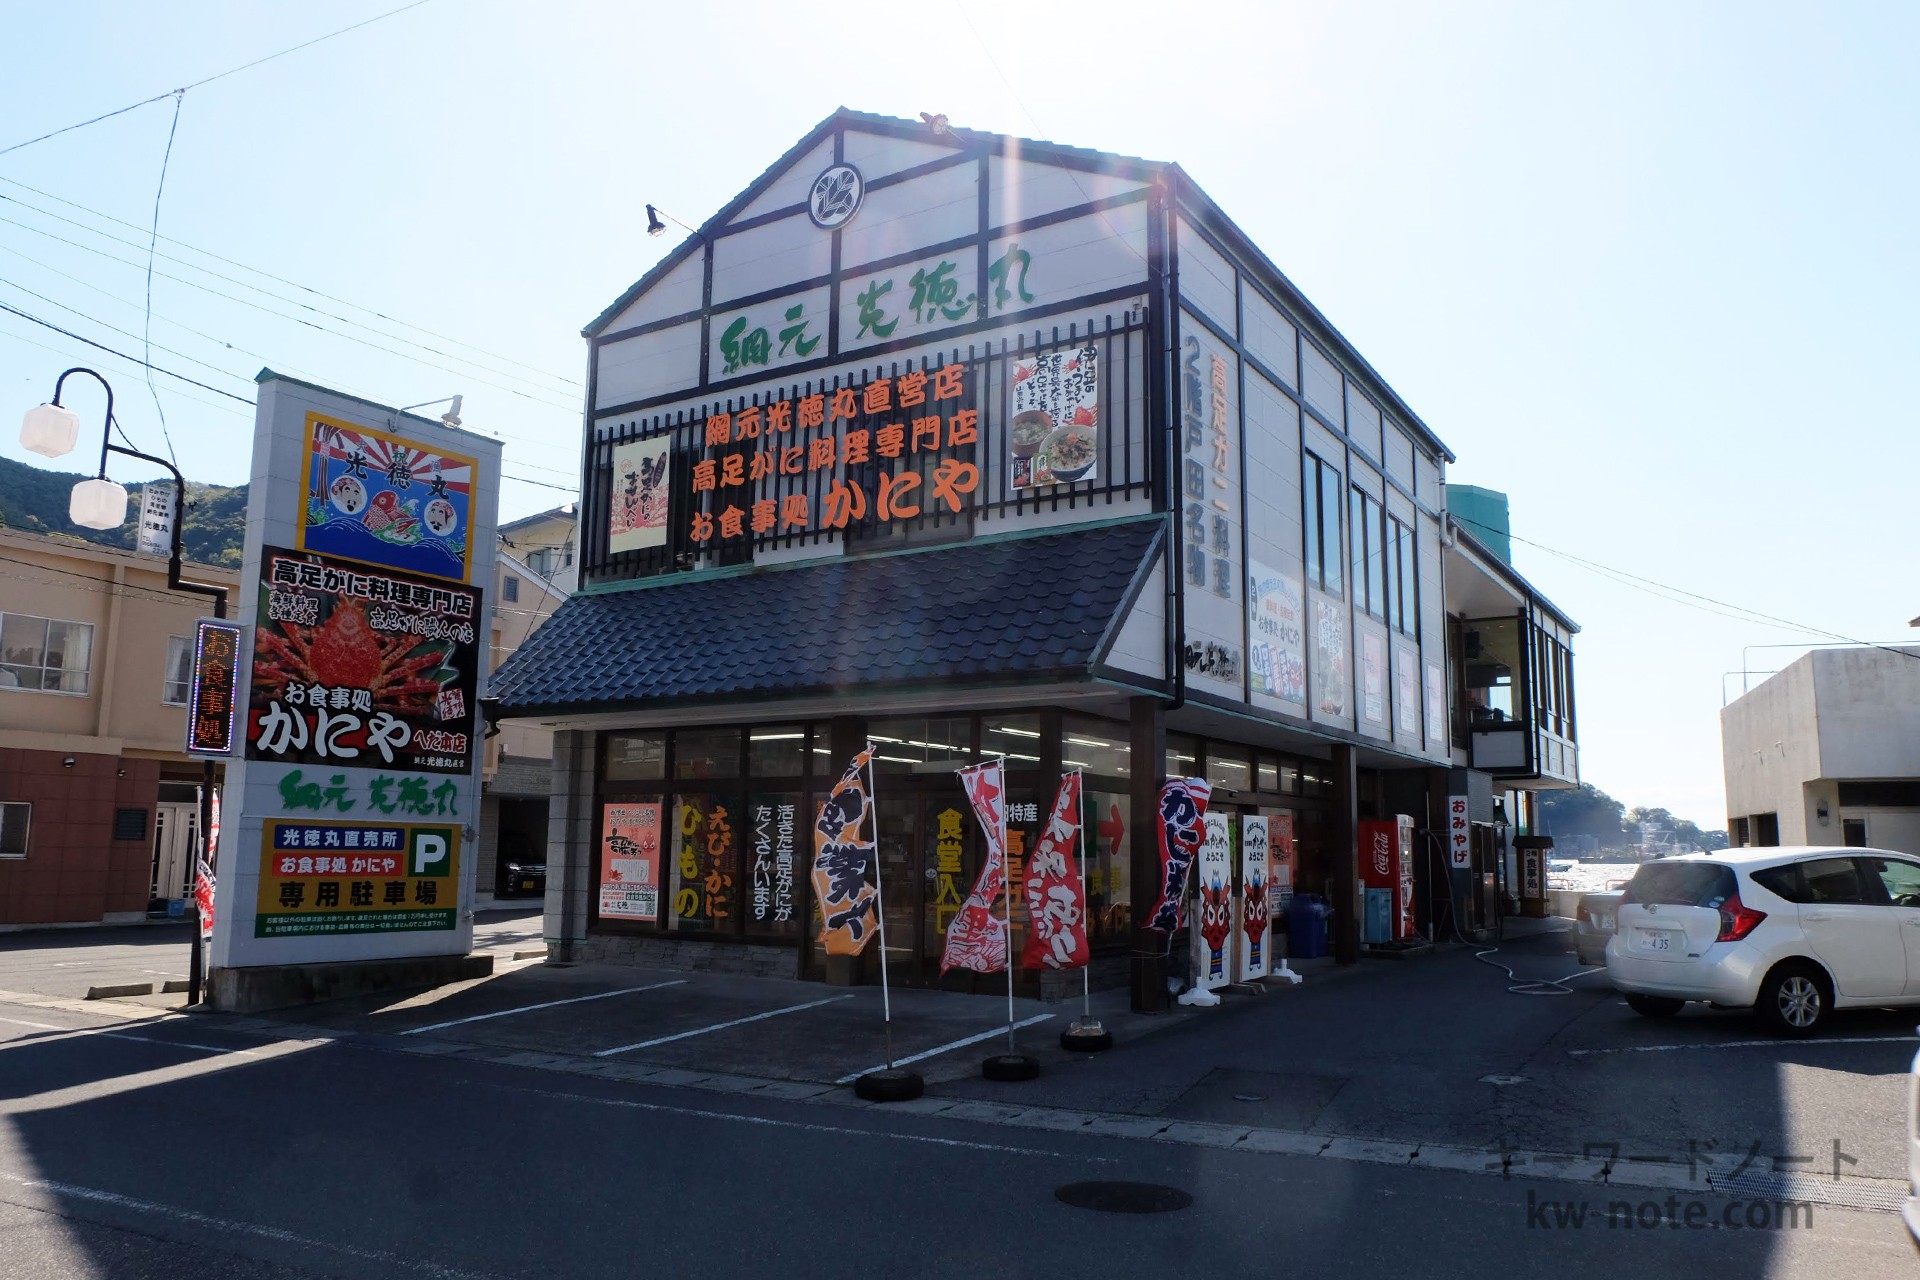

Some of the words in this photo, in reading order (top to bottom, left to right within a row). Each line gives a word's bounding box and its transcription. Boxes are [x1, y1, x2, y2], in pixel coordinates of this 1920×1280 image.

[721, 304, 822, 374] 網元
[857, 243, 1035, 339] 光徳丸
[705, 362, 967, 447] 網元光徳丸直営店
[345, 451, 450, 500] 光徳丸
[692, 408, 978, 494] 高足がに料理専門店
[690, 494, 808, 542] お食事処
[822, 459, 980, 529] かにや
[144, 520, 169, 533] 光徳丸
[269, 591, 319, 611] 海鮮料理
[273, 557, 473, 617] 高足がに料理専門店
[284, 682, 372, 712] お食事処
[257, 701, 411, 763] かにや
[413, 730, 467, 754] へだ本店
[278, 769, 357, 812] 網元
[368, 774, 458, 816] 光徳丸
[283, 829, 398, 847] 光徳丸直売所
[414, 834, 446, 873] P
[1373, 830, 1390, 875] Coca-Cola
[1452, 800, 1468, 863] おみやげ
[280, 857, 347, 874] お食事処
[351, 858, 396, 873] かにや
[675, 804, 702, 918] ひもの
[704, 804, 733, 919] えび・かに
[753, 805, 773, 921] たくさんいます
[773, 804, 795, 921] 活きた高足がにが
[936, 807, 963, 935] 食堂入口
[1206, 851, 1224, 862] ようこそ
[1249, 851, 1264, 862] ようこそ
[278, 880, 438, 908] 専用駐車場
